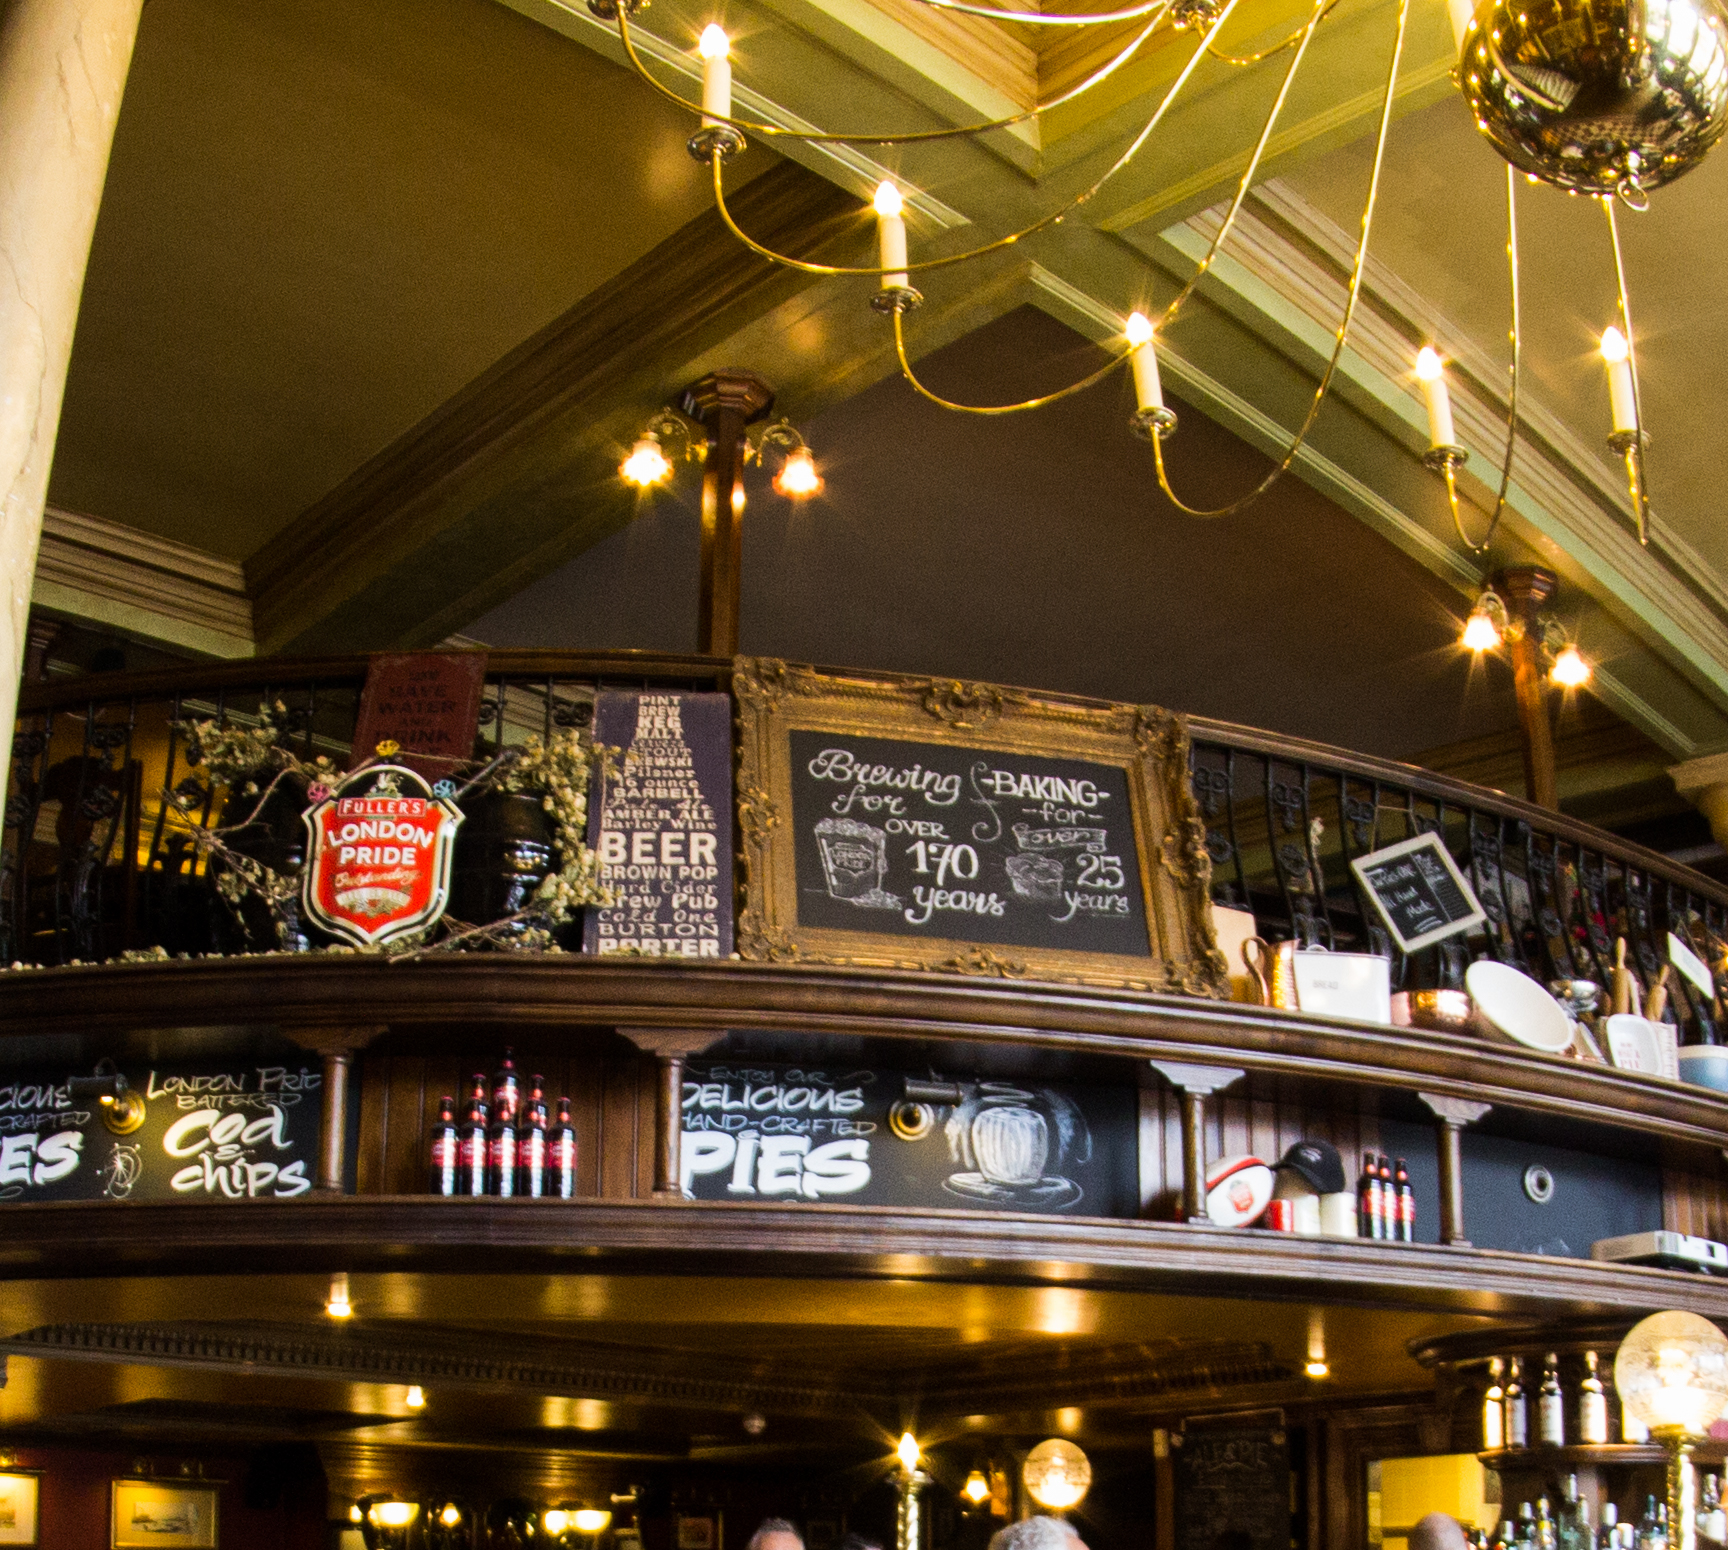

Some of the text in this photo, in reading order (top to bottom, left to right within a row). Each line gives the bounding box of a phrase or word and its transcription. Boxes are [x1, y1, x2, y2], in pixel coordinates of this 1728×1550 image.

[638, 694, 682, 706] PINT
[638, 705, 681, 717] BREW
[637, 716, 682, 729] KEG
[635, 728, 684, 740] MALT
[624, 766, 696, 778] Pilsner
[807, 748, 962, 805] Brewing
[644, 780, 700, 788] ounce
[613, 787, 705, 799] BARBELL
[831, 784, 906, 814] for
[342, 799, 421, 815] FULLER'S
[602, 808, 715, 820] AMBER ALE
[601, 819, 718, 831] Barley Wine
[885, 818, 950, 840] OVER
[327, 820, 435, 848] LONDON
[1030, 829, 1091, 846] over
[339, 846, 417, 865] PRIDE
[600, 831, 718, 865] BEER
[905, 841, 979, 887] 170
[1075, 852, 1126, 888] 25
[600, 865, 719, 880] BROWN POP
[660, 880, 718, 894] Cider
[671, 892, 719, 909] Pub
[904, 886, 1005, 925] years
[1049, 888, 1130, 923] years
[598, 908, 717, 923] Cold One
[598, 922, 719, 937] BURTON
[598, 937, 720, 958] PORTER
[147, 1070, 246, 1100] LONDON
[176, 1094, 303, 1110] BATTERED
[163, 1104, 294, 1158] Cod
[214, 1144, 245, 1160] &
[170, 1151, 312, 1199] chips
